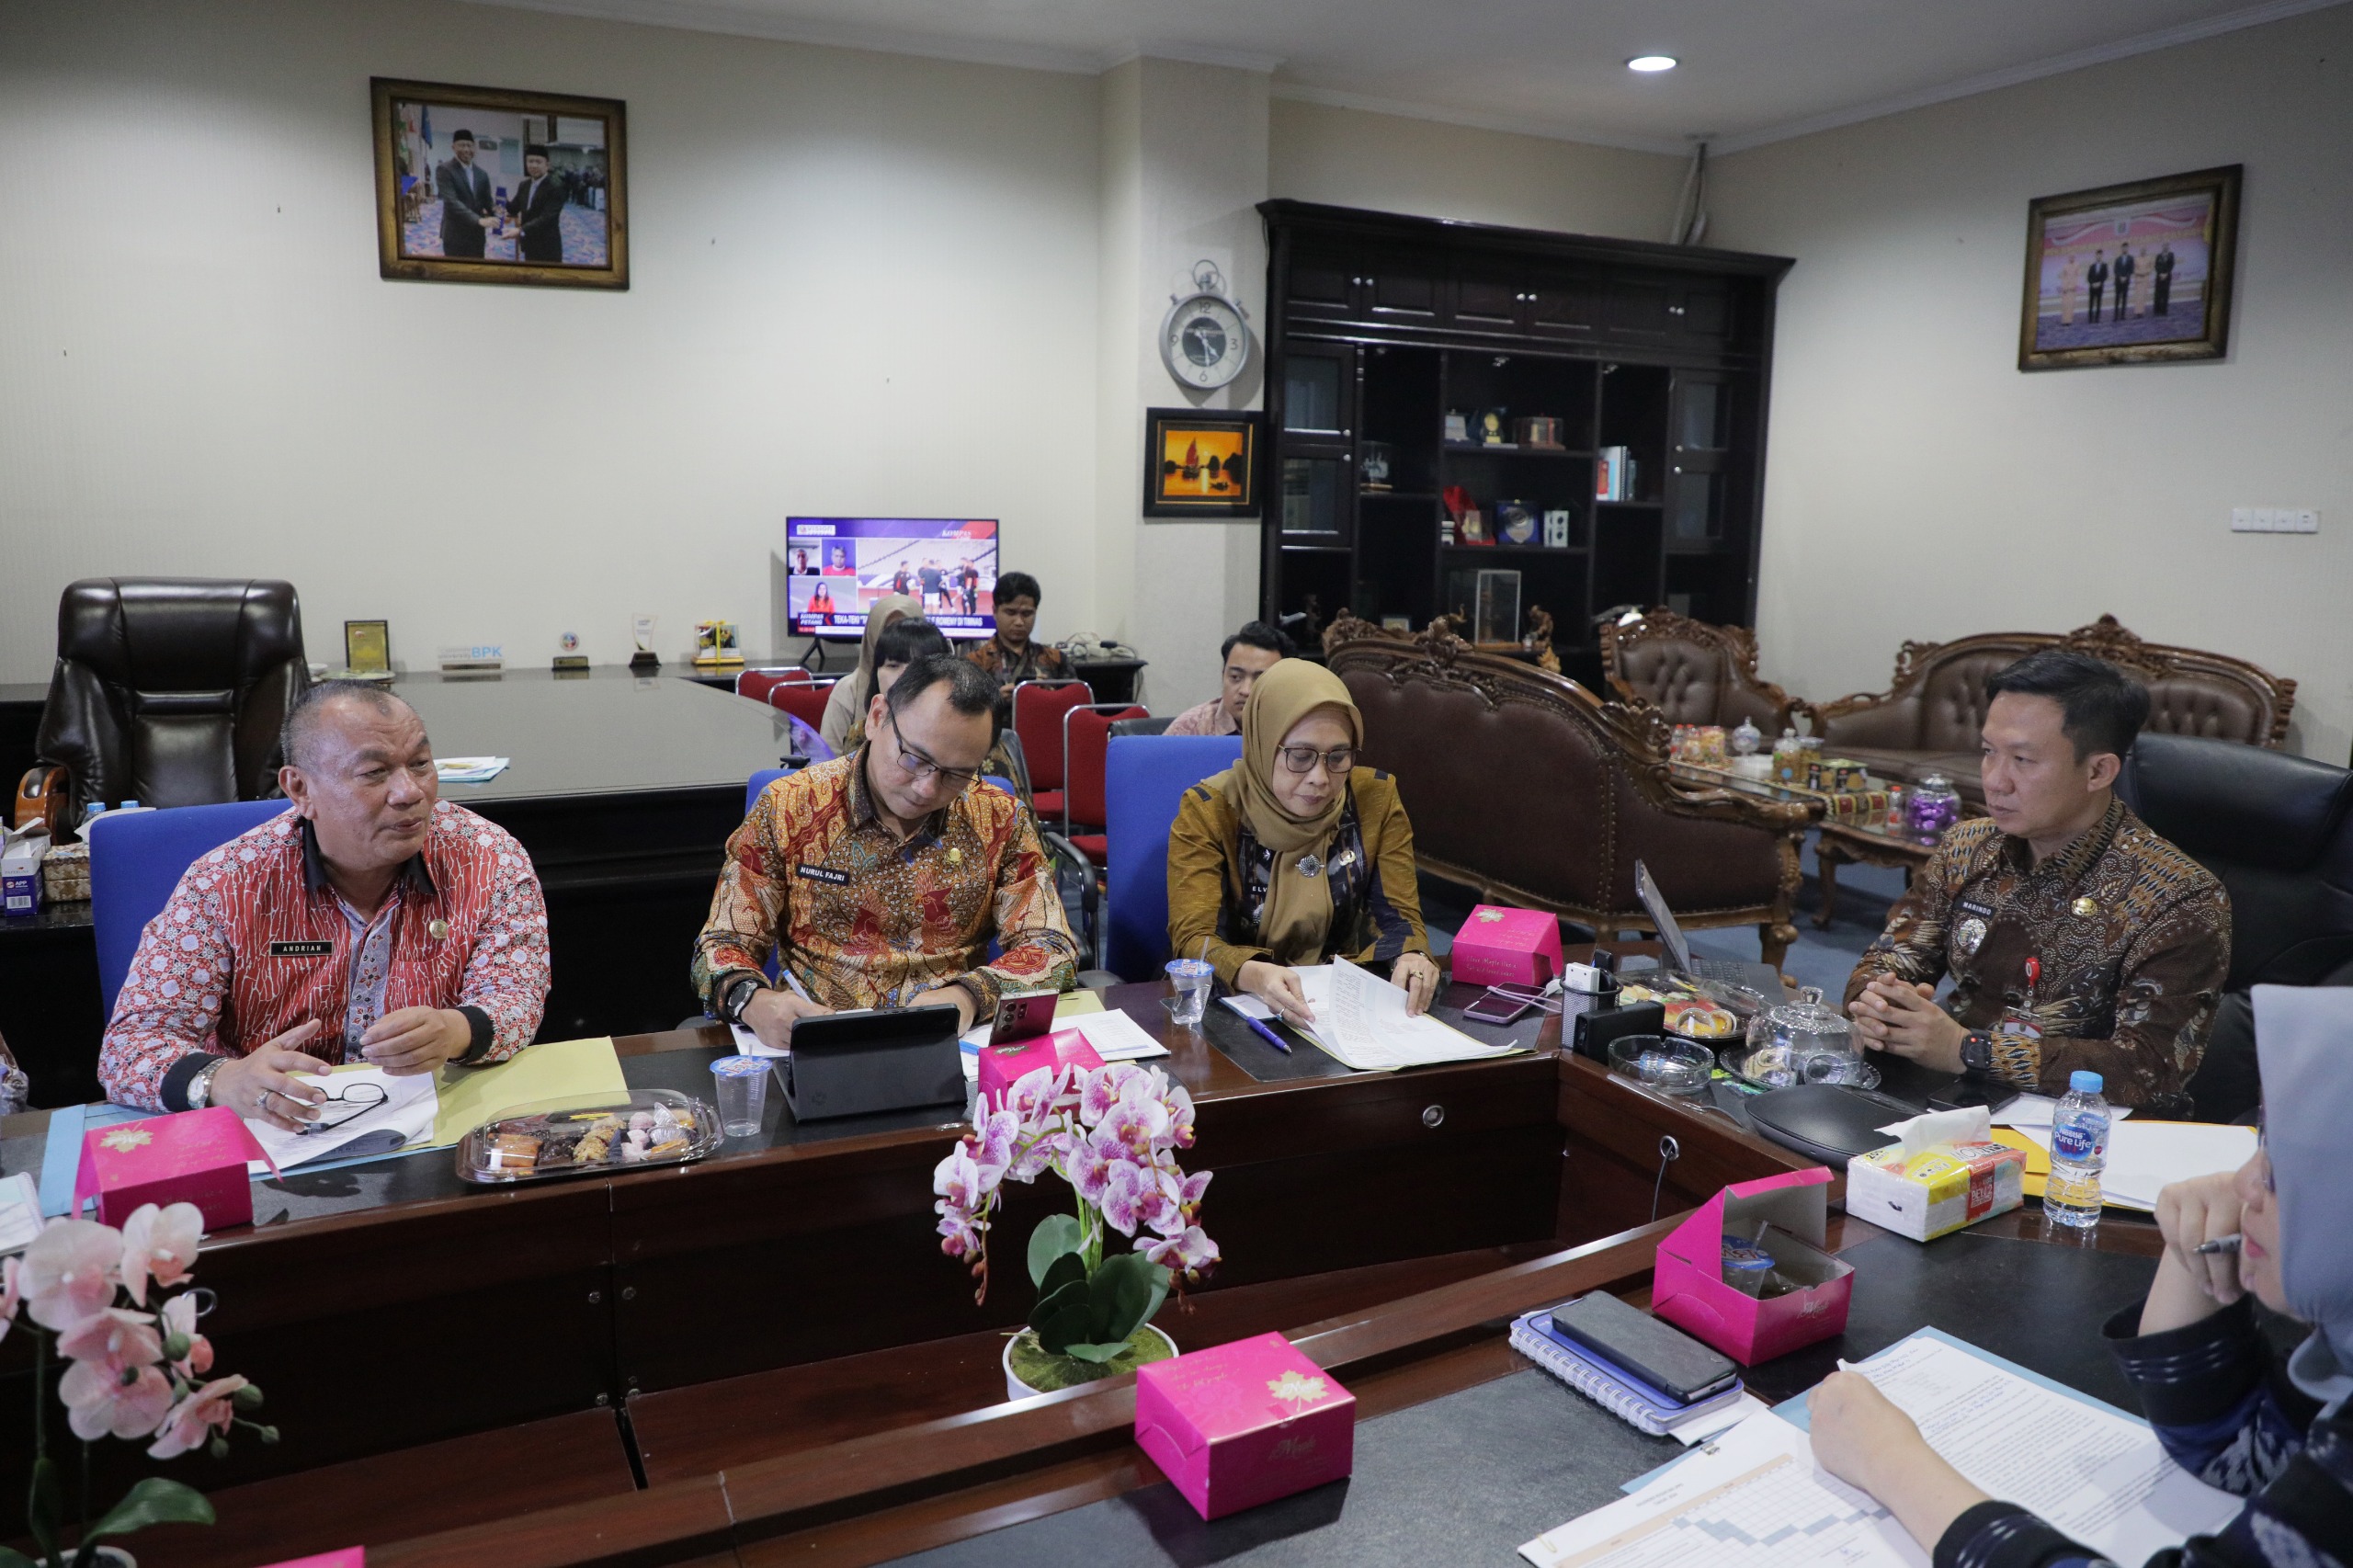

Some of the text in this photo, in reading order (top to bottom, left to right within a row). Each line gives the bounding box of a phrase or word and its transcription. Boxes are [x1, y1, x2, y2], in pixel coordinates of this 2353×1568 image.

[1199, 302, 1212, 314] 12
[1170, 335, 1178, 347] 9
[1231, 338, 1238, 350] 3
[1199, 369, 1208, 382] 6
[472, 646, 502, 658] BPK
[800, 866, 845, 881] NURUL FAJRI
[1962, 901, 1992, 915] MARINDO
[2054, 1131, 2091, 1151] Pure Life
